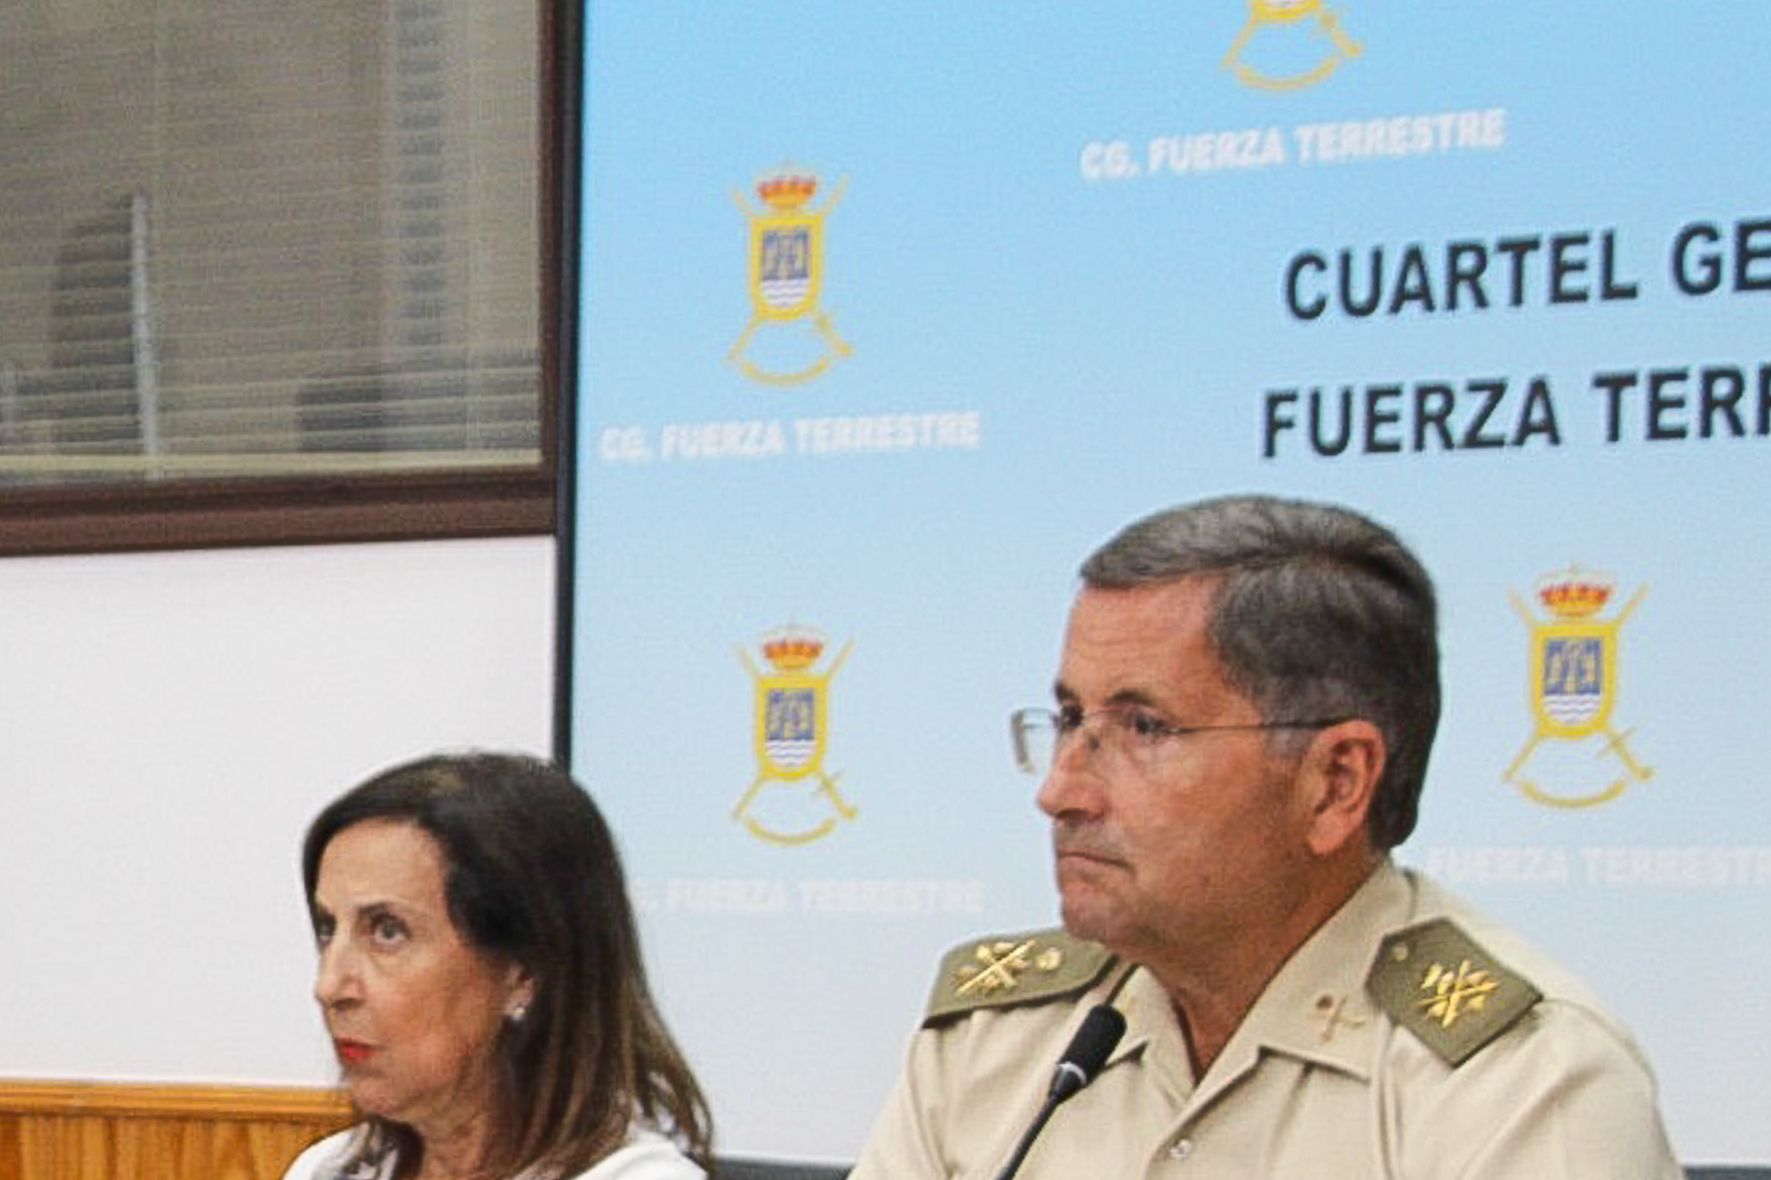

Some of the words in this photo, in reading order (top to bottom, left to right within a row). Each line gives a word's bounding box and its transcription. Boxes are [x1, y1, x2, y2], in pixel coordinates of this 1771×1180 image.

[1148, 126, 1286, 174] FUERZA
[1294, 107, 1508, 163] TERRESTRE
[1284, 228, 1640, 321] CUARTEL
[662, 419, 784, 457] FUERZA
[794, 410, 980, 453] TERRESTRE
[1262, 375, 1562, 459] FUERZA
[667, 878, 789, 912] FUERZA
[796, 879, 986, 915] TERRESTRE
